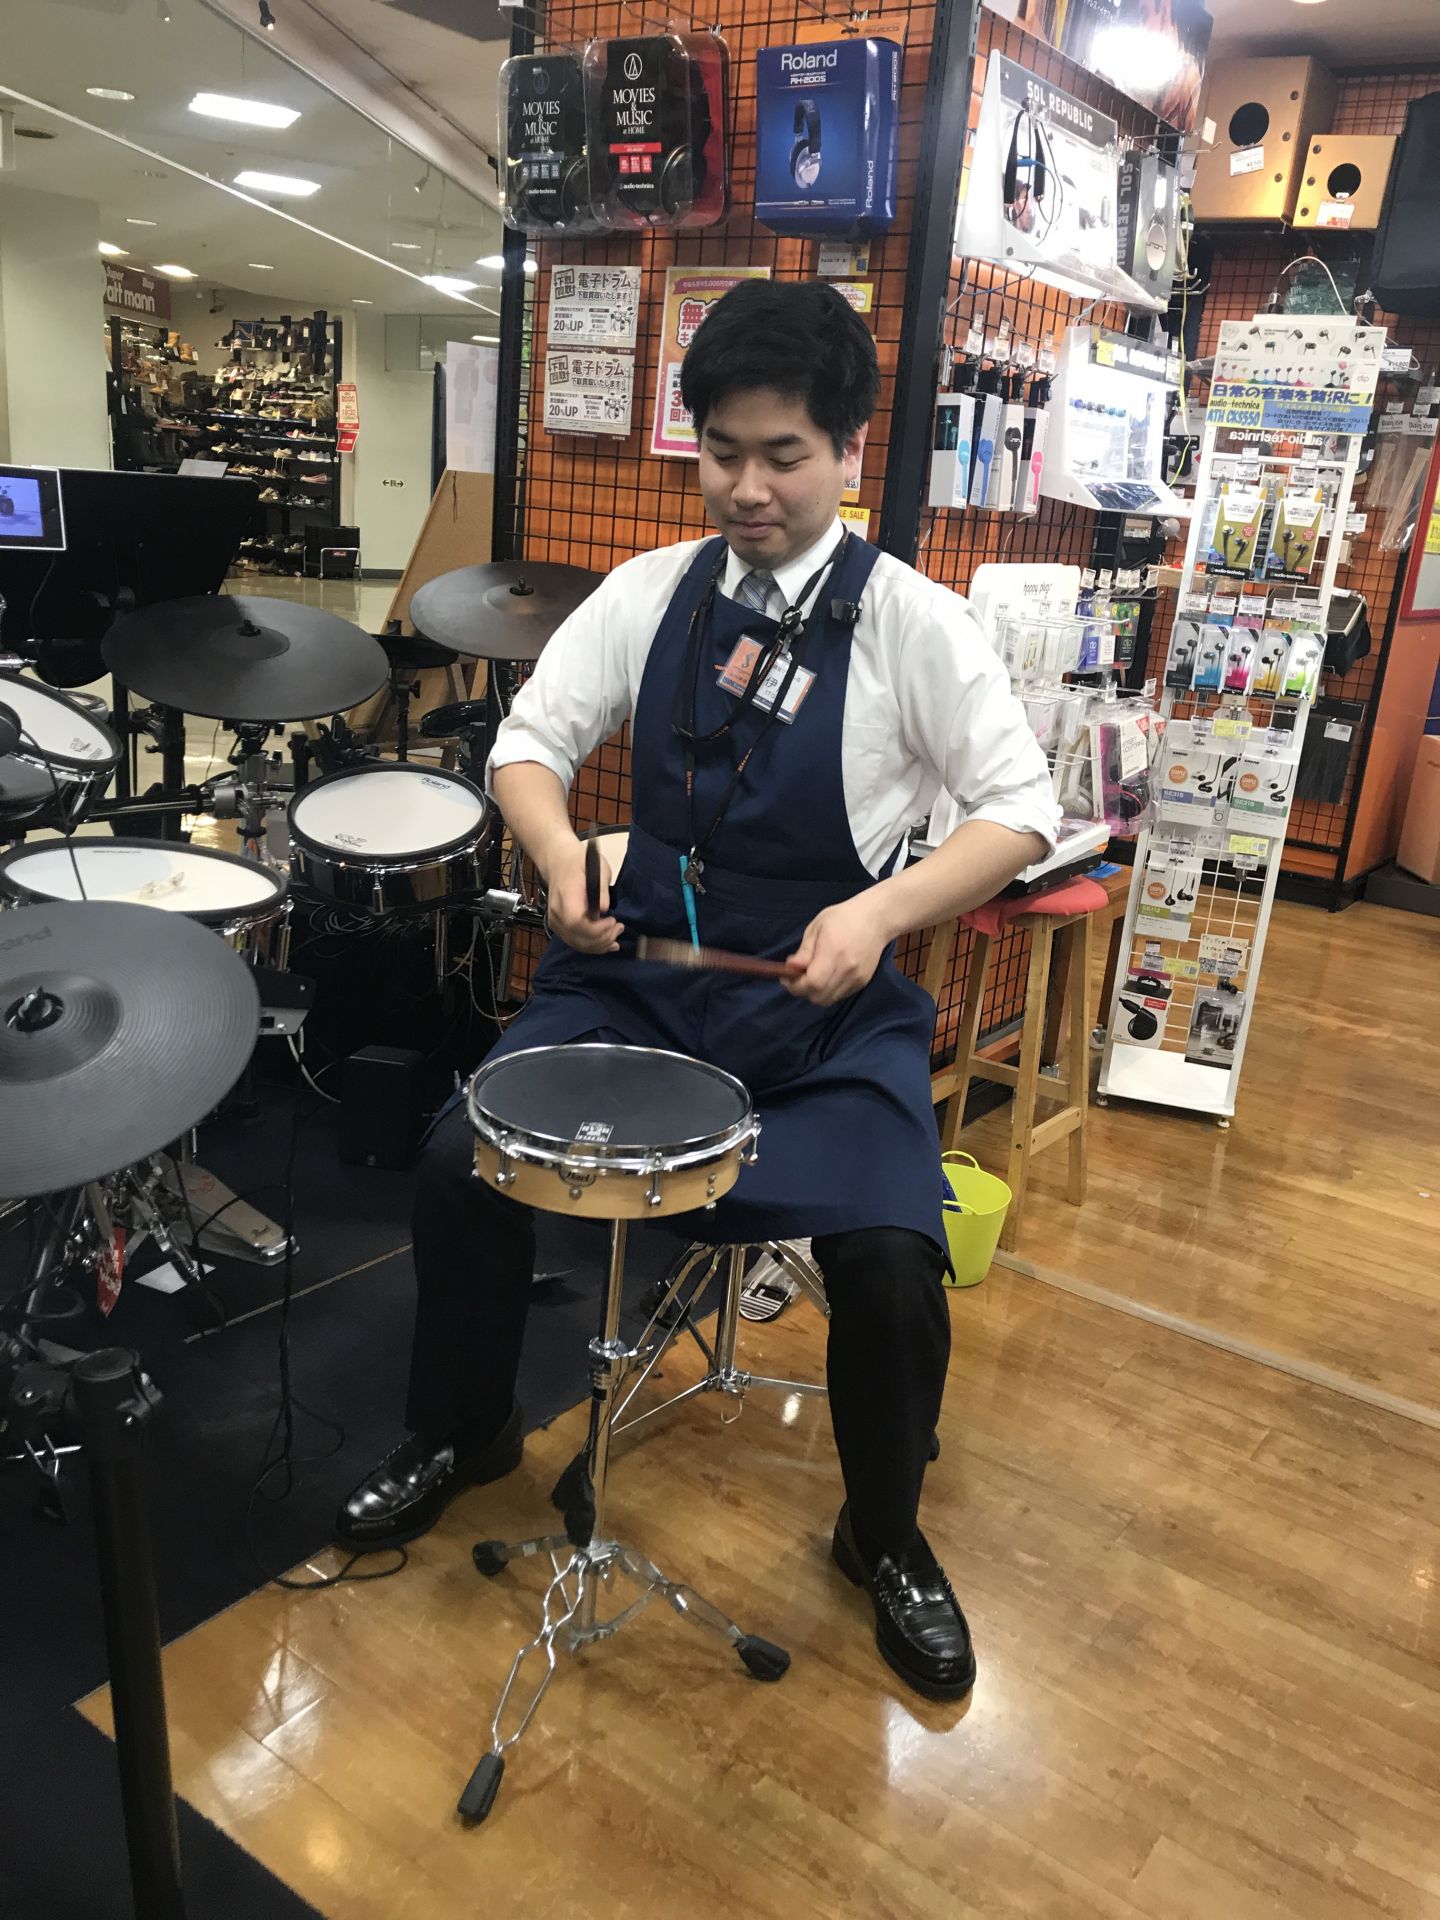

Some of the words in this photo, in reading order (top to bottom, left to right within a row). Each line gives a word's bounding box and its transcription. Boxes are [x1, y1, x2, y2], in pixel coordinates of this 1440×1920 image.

[781, 49, 838, 71] Roland
[613, 88, 656, 104] MOVIES
[522, 101, 561, 116] MOVIES
[1027, 80, 1046, 107] SOL
[1048, 93, 1094, 132] REPUBLIC
[616, 110, 653, 126] MUSIC
[525, 121, 558, 136] MUSIC
[628, 126, 645, 134] HOME
[865, 160, 875, 208] Roland
[1120, 162, 1134, 197] SOL
[578, 272, 631, 288] 電子ドラム
[572, 359, 625, 376] 電子ドラム
[849, 510, 865, 520] SALE
[421, 776, 451, 790] Roland
